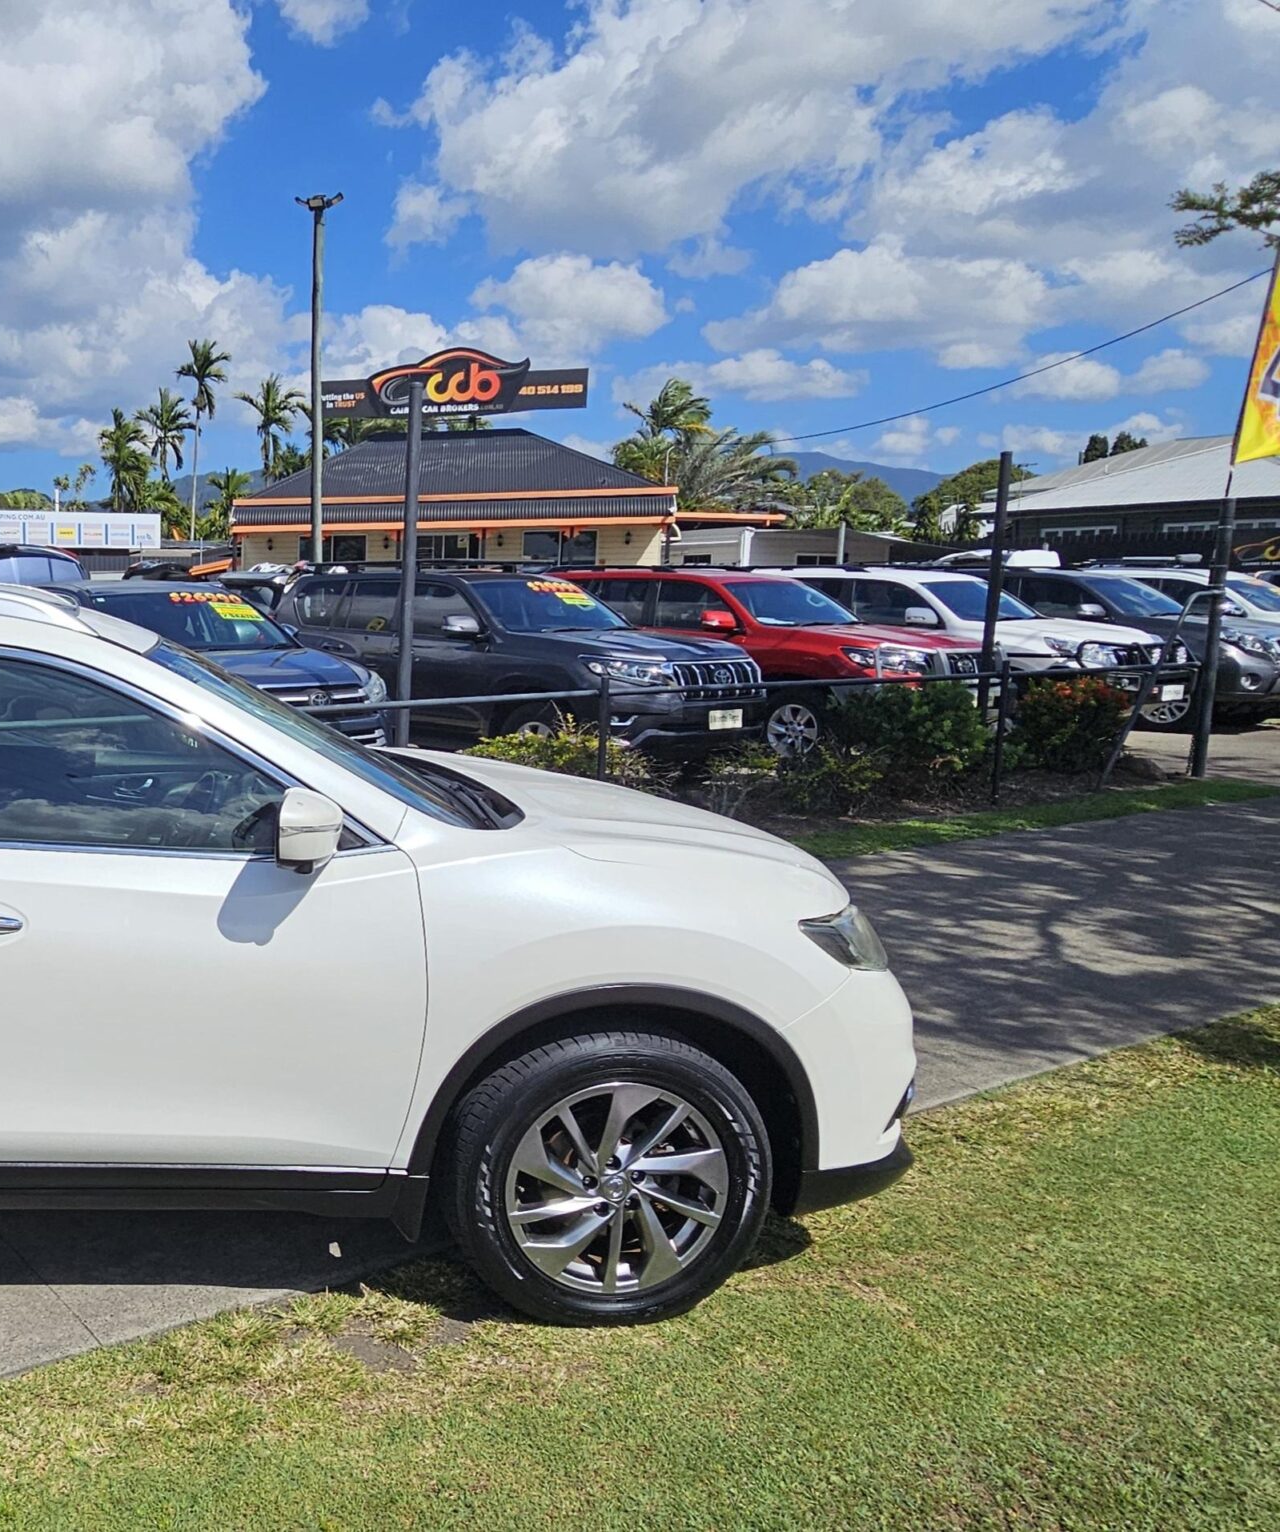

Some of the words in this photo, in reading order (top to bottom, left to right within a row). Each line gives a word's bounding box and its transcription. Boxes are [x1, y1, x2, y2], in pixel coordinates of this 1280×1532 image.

[518, 385, 536, 395] 40
[537, 384, 559, 394] 514
[343, 392, 354, 400] the
[334, 400, 357, 408] TRUST
[390, 407, 409, 415] CAIR
[422, 405, 439, 413] CAR
[169, 592, 243, 604] $26990
